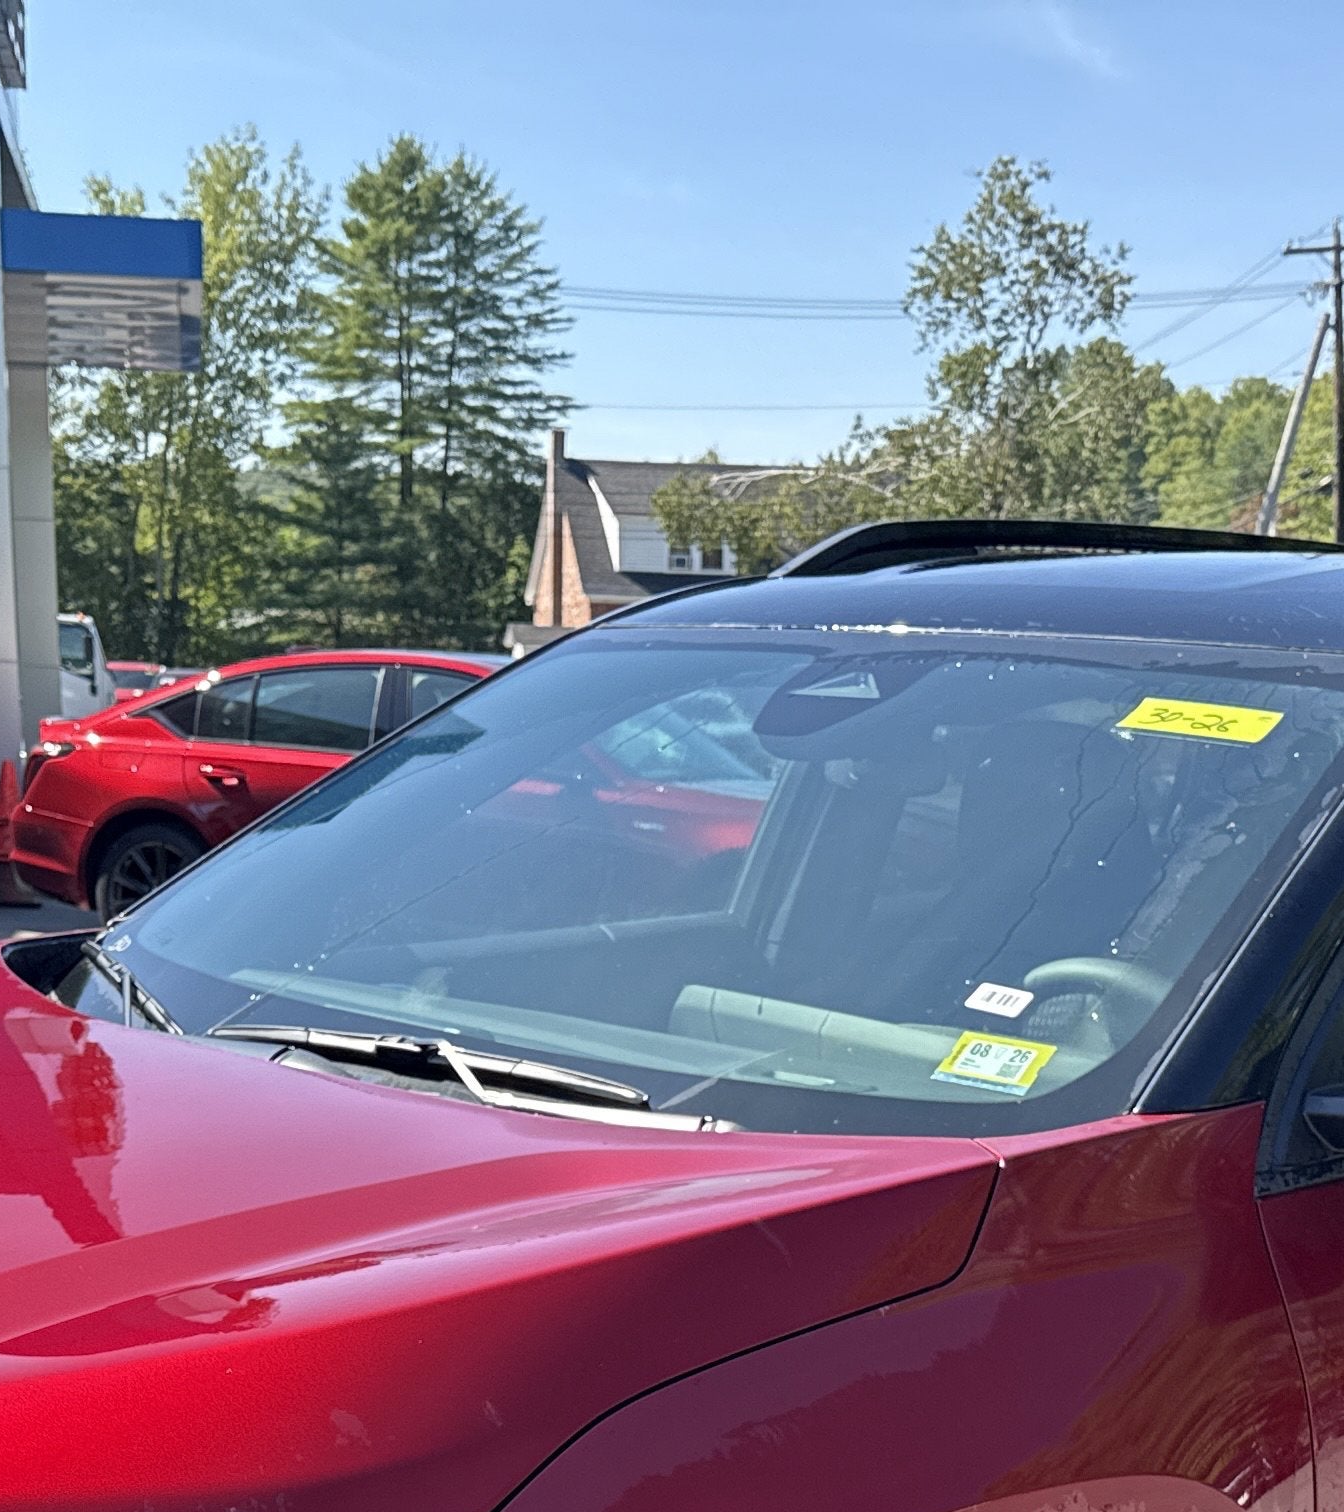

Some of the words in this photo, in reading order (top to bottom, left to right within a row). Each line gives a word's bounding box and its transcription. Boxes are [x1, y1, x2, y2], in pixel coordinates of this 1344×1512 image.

[1137, 708, 1239, 733] 30-26
[969, 1042, 993, 1058] 08
[1008, 1048, 1033, 1064] 26
